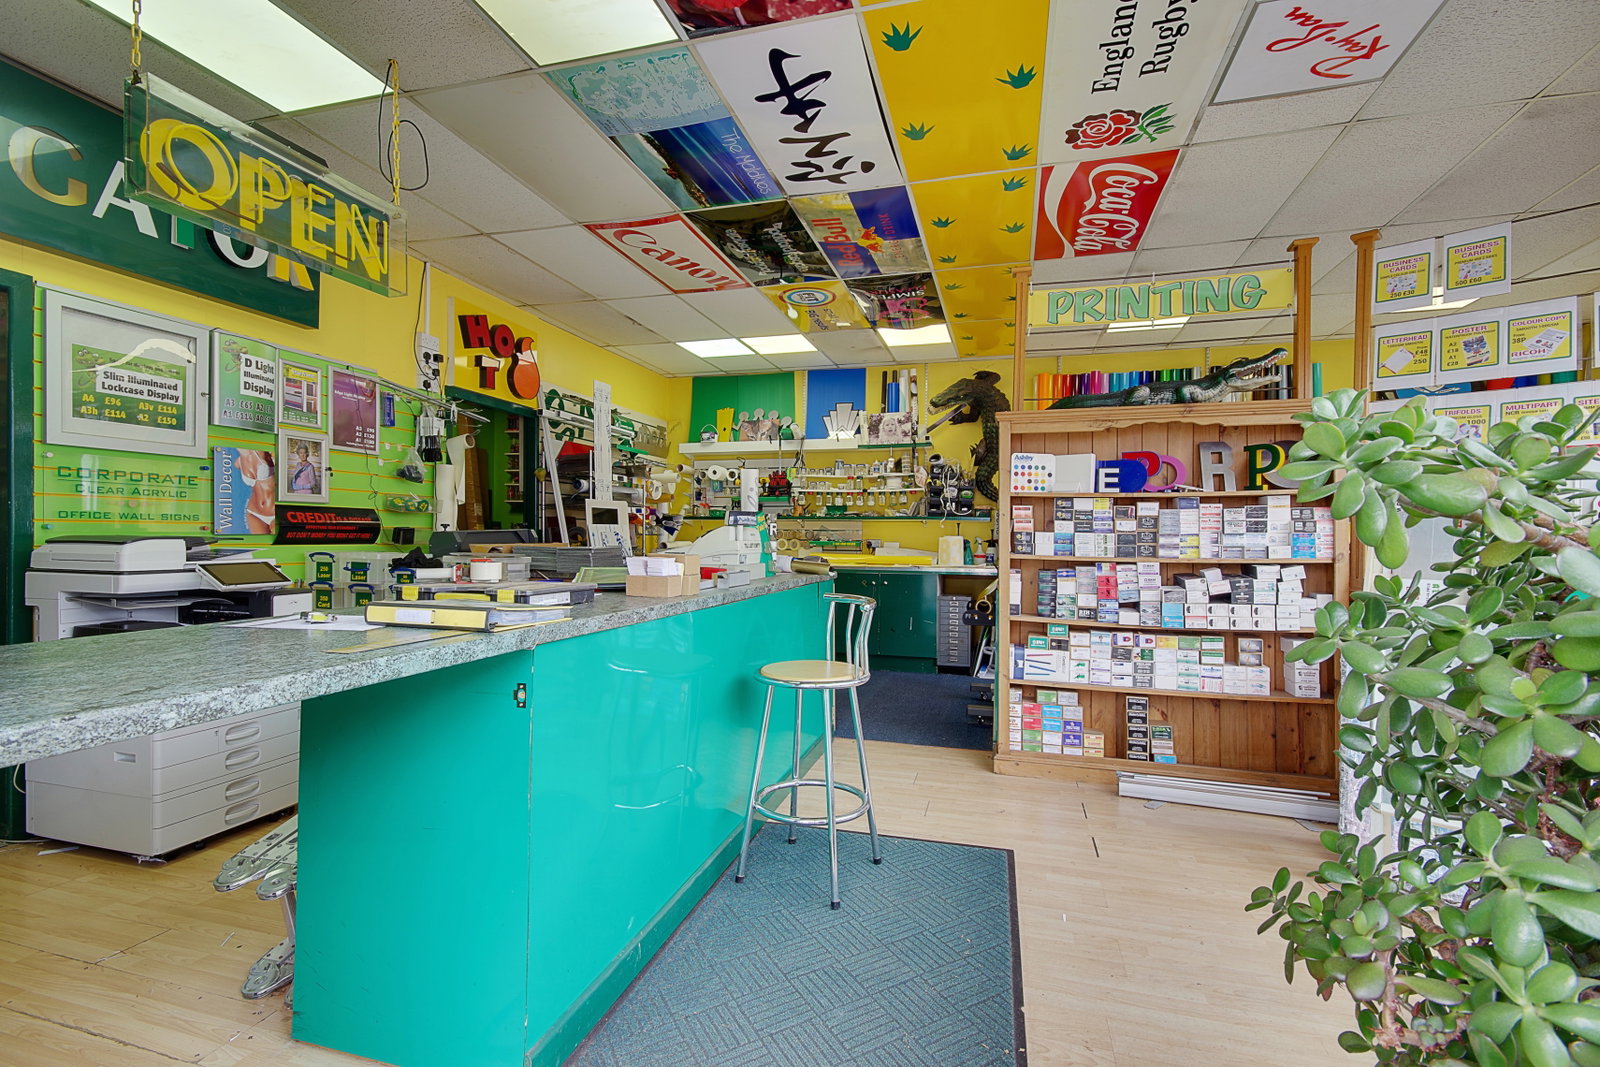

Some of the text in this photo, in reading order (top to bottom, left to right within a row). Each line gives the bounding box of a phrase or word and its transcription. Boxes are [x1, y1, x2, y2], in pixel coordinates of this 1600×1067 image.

[1091, 0, 1138, 94] Englan
[721, 128, 742, 154] The
[140, 119, 389, 282] OPEN
[811, 218, 864, 266] Red Bull
[1454, 240, 1500, 254] BUSINESS
[613, 229, 740, 288] Canon
[1462, 248, 1492, 258] CARDS
[1383, 257, 1424, 269] BUSINESS
[1390, 264, 1417, 274] CARDS
[1047, 275, 1267, 325] PRINTING
[1452, 326, 1487, 334] POSTER
[1383, 334, 1428, 344] LETTERHEAD
[1512, 348, 1546, 358] RICOH
[245, 358, 274, 375] D Light
[104, 371, 178, 391] Slim Illuminated
[244, 371, 274, 384] Illuminated
[102, 382, 180, 403] Lockcase Display
[244, 381, 274, 398] Display
[1444, 408, 1482, 416] TRIFOLDS
[1506, 401, 1558, 411] MULTIPART
[58, 466, 198, 486] CORPORATE
[1098, 468, 1120, 492] E
[76, 484, 188, 499] CLEAR ACRYLIC
[220, 450, 234, 530] Wall Decor
[58, 510, 200, 522] OFFICE WALL SIGNS
[286, 512, 336, 523] CREDIT
